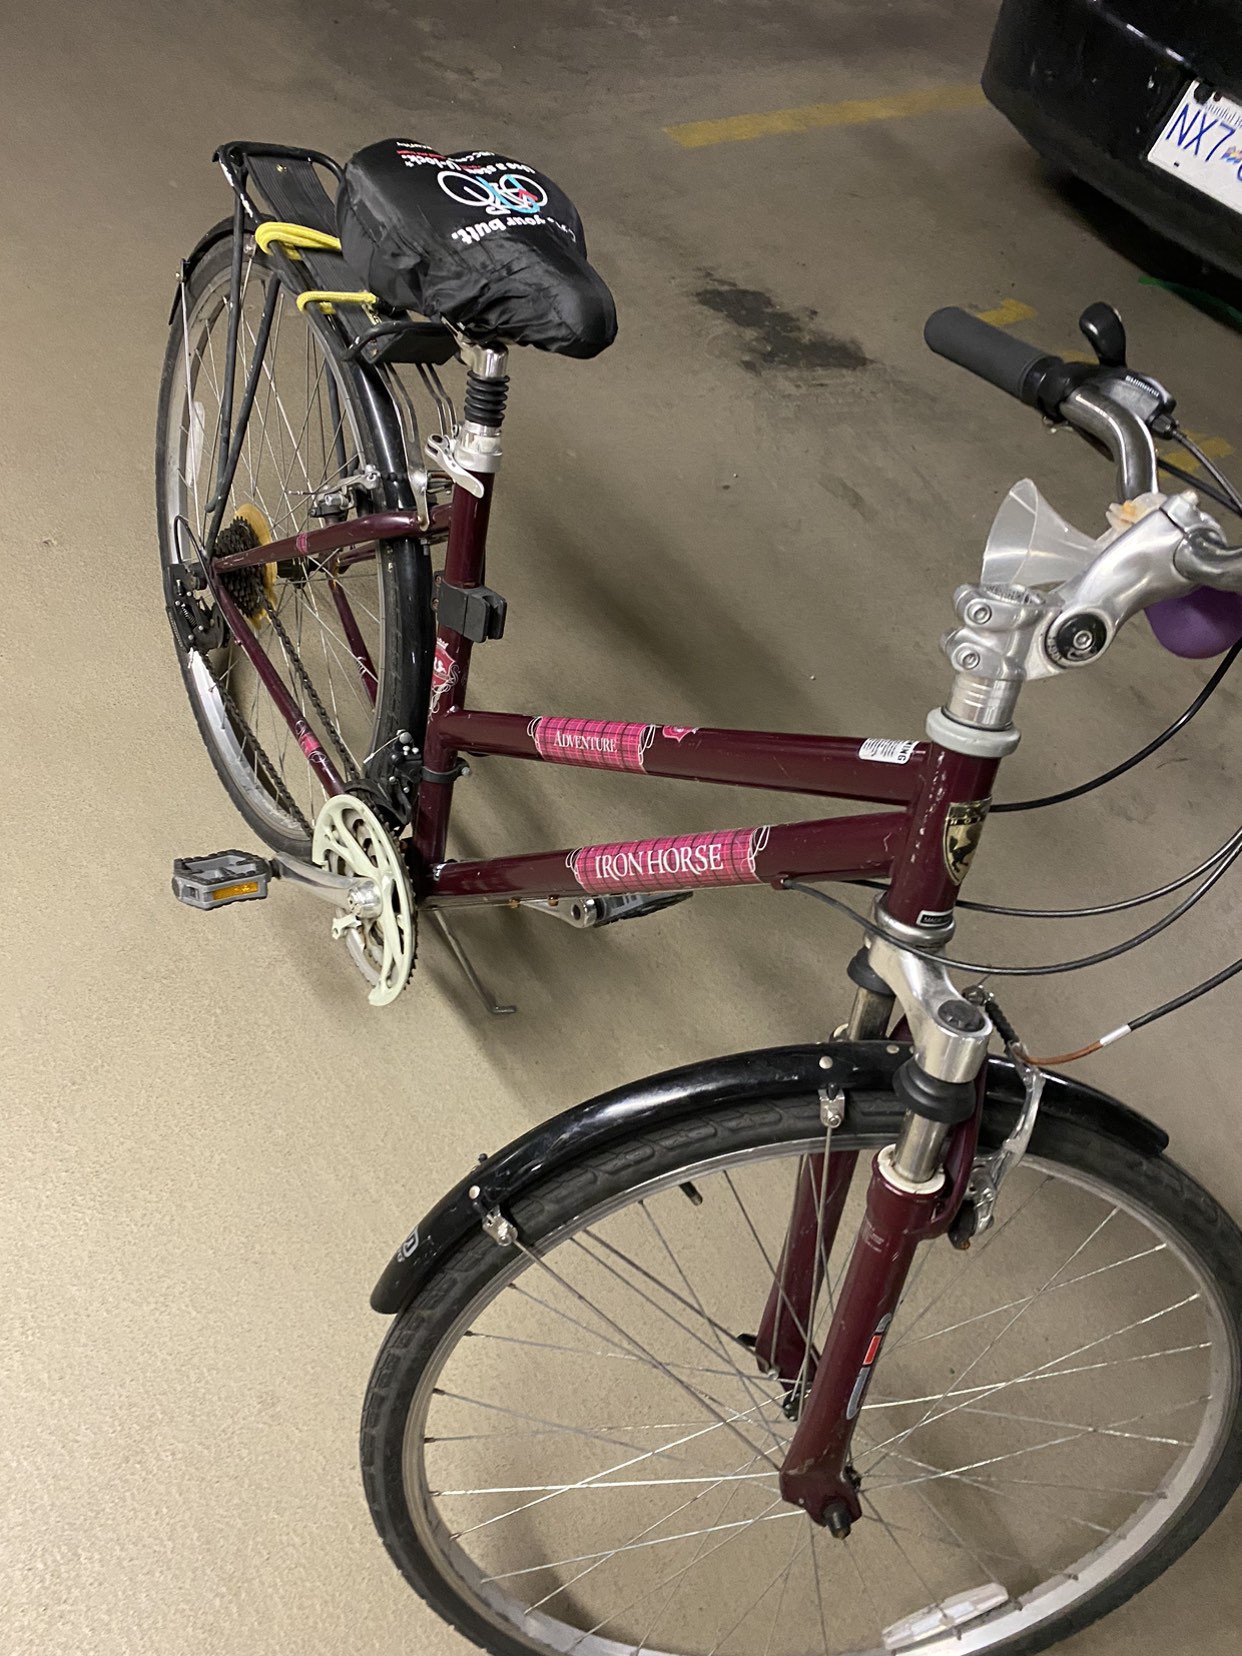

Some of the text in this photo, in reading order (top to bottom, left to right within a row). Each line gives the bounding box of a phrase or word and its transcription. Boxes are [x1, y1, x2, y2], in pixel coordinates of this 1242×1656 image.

[1165, 103, 1236, 162] NX7
[451, 214, 546, 245] your butt.
[553, 730, 618, 753] ADVENTURE
[595, 843, 724, 881] IRON HORSE
